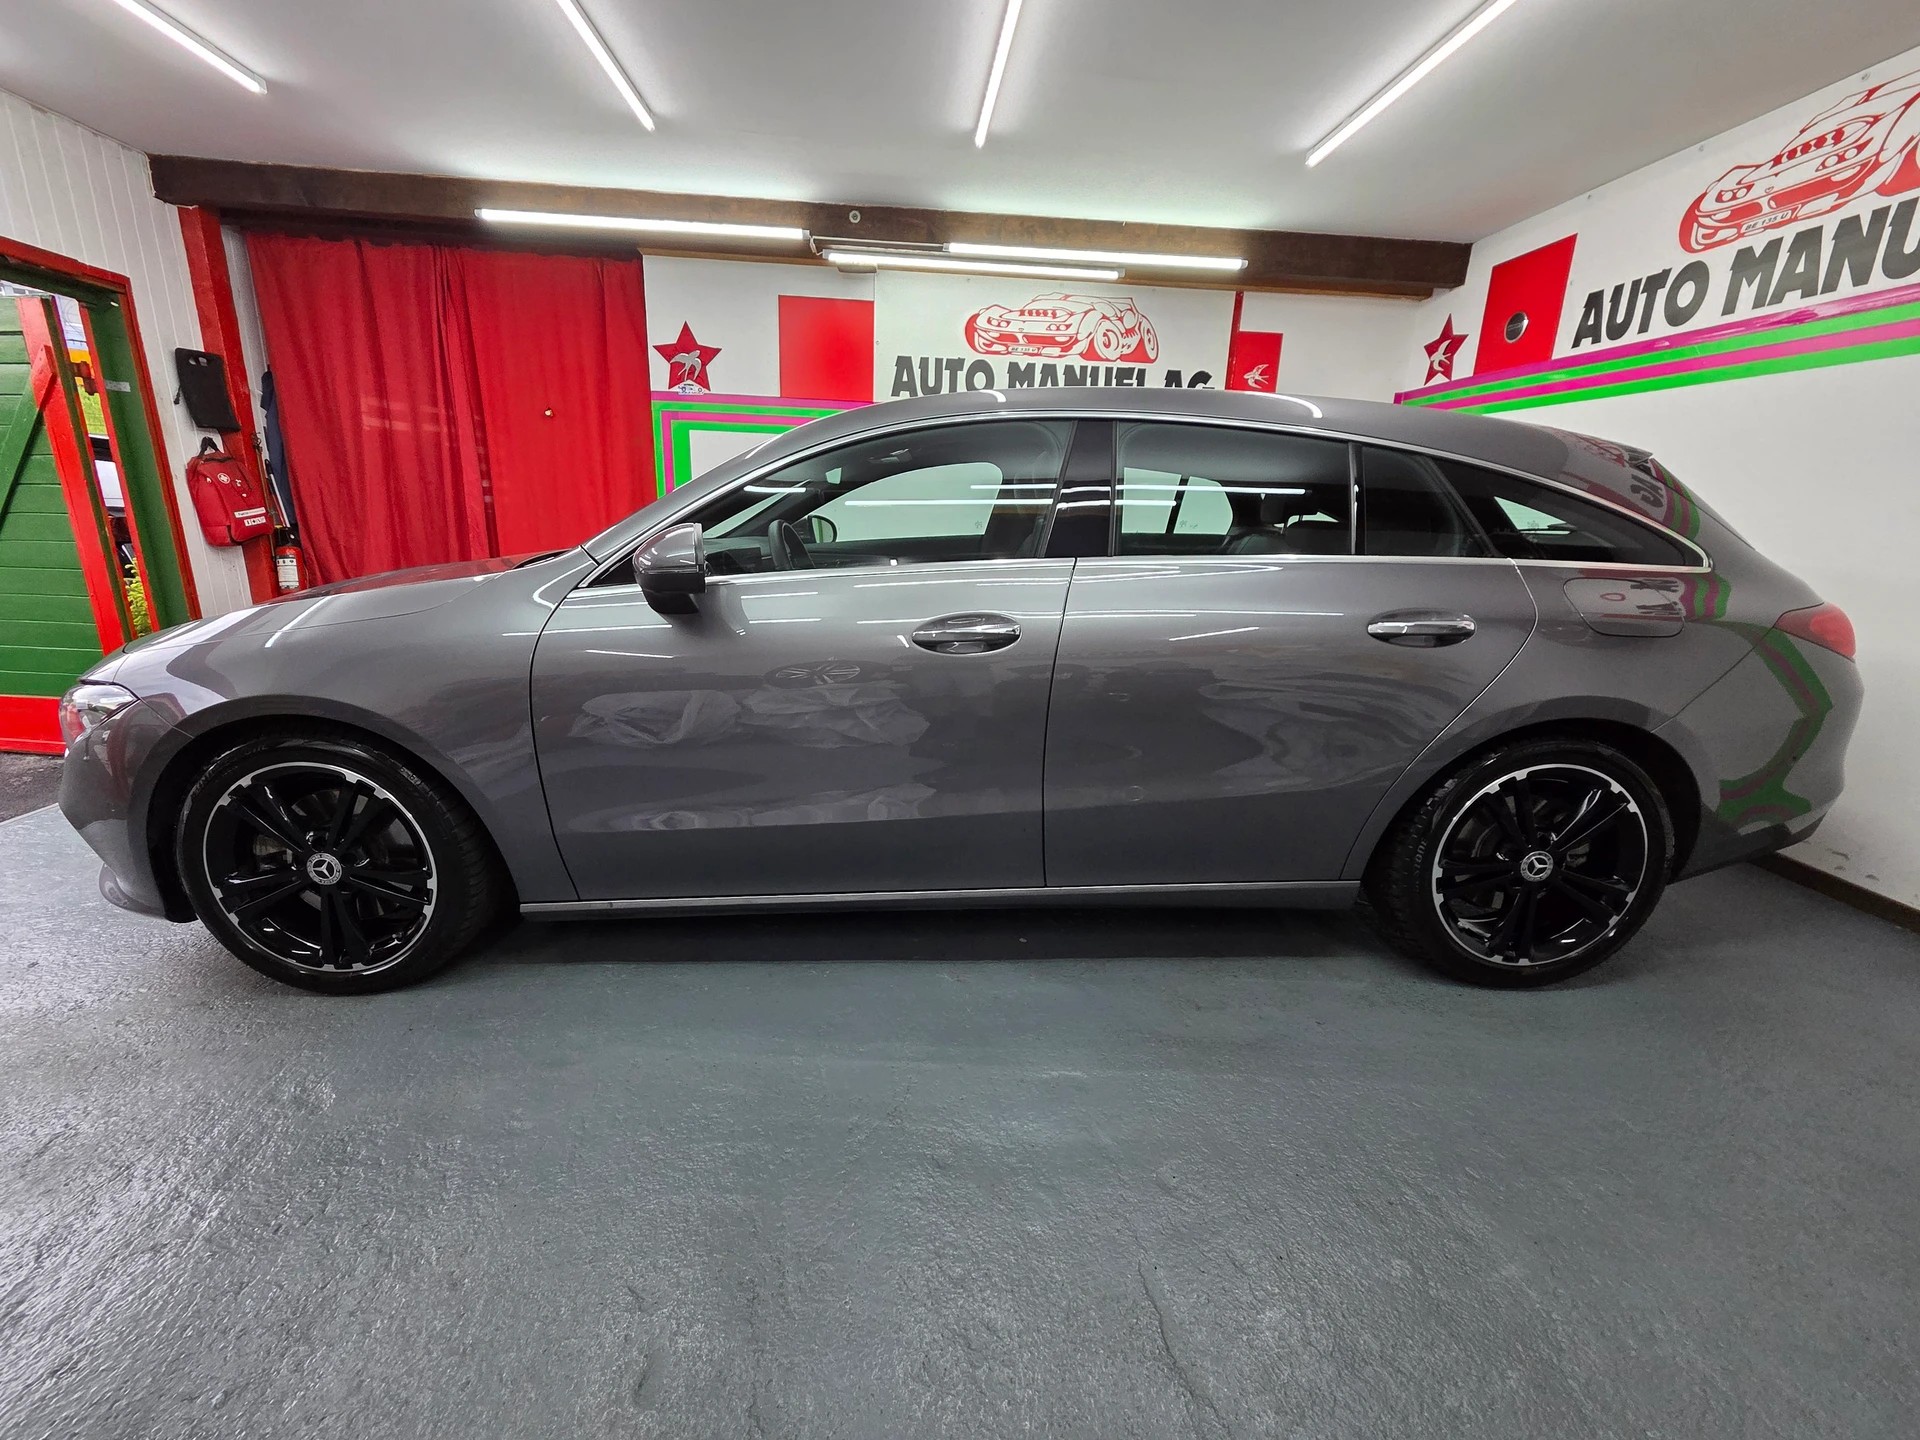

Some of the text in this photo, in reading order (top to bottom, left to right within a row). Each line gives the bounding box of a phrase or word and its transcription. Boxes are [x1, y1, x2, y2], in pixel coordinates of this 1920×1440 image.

[1761, 215, 1778, 226] 135
[1571, 259, 1710, 349] AUTO
[891, 355, 996, 397] AUTO
